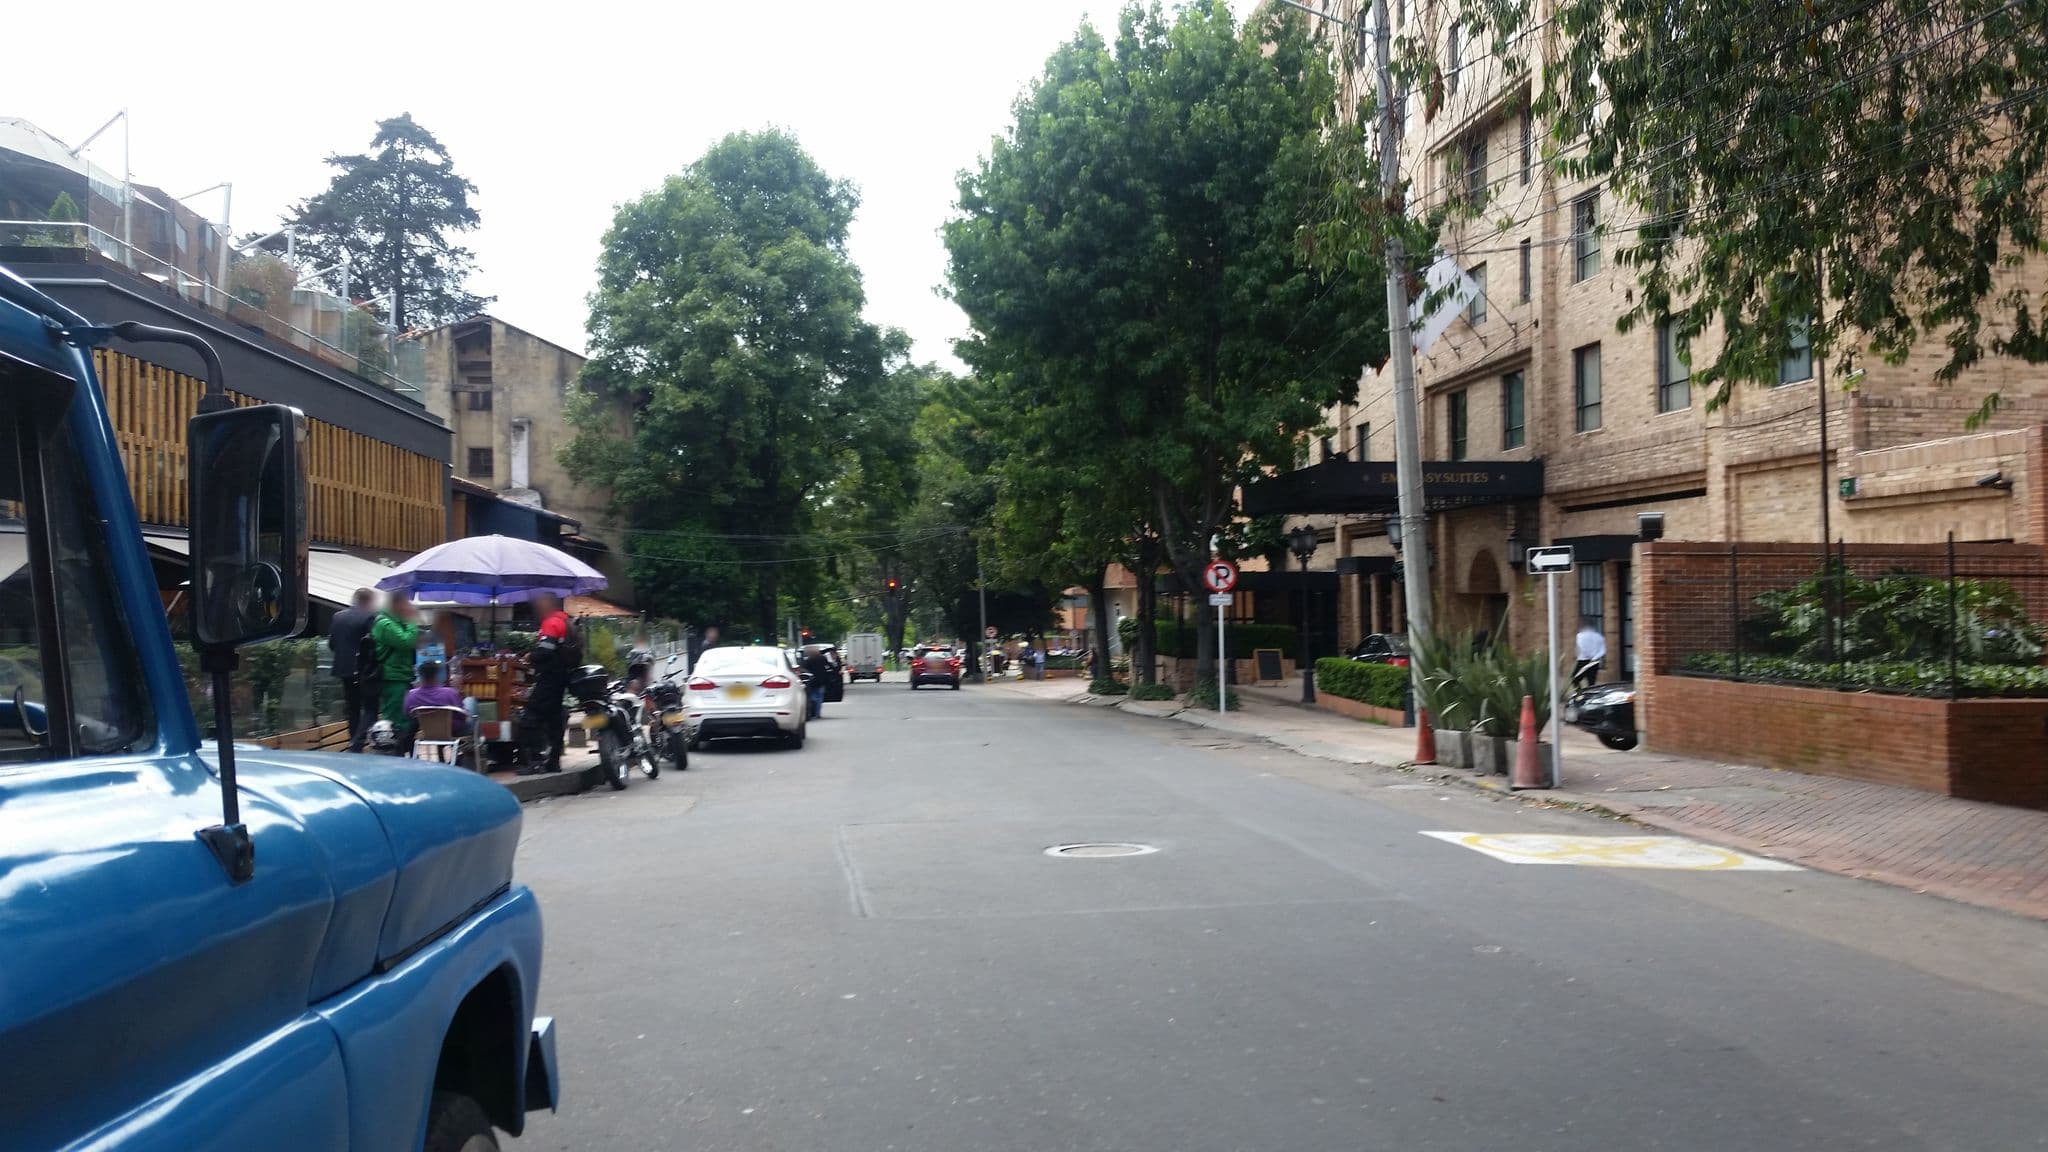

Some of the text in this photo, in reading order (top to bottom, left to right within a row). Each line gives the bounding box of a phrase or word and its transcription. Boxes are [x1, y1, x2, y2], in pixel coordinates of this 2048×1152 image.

[1381, 472, 1489, 484] EMSY SUITES
[1215, 565, 1230, 587] P
